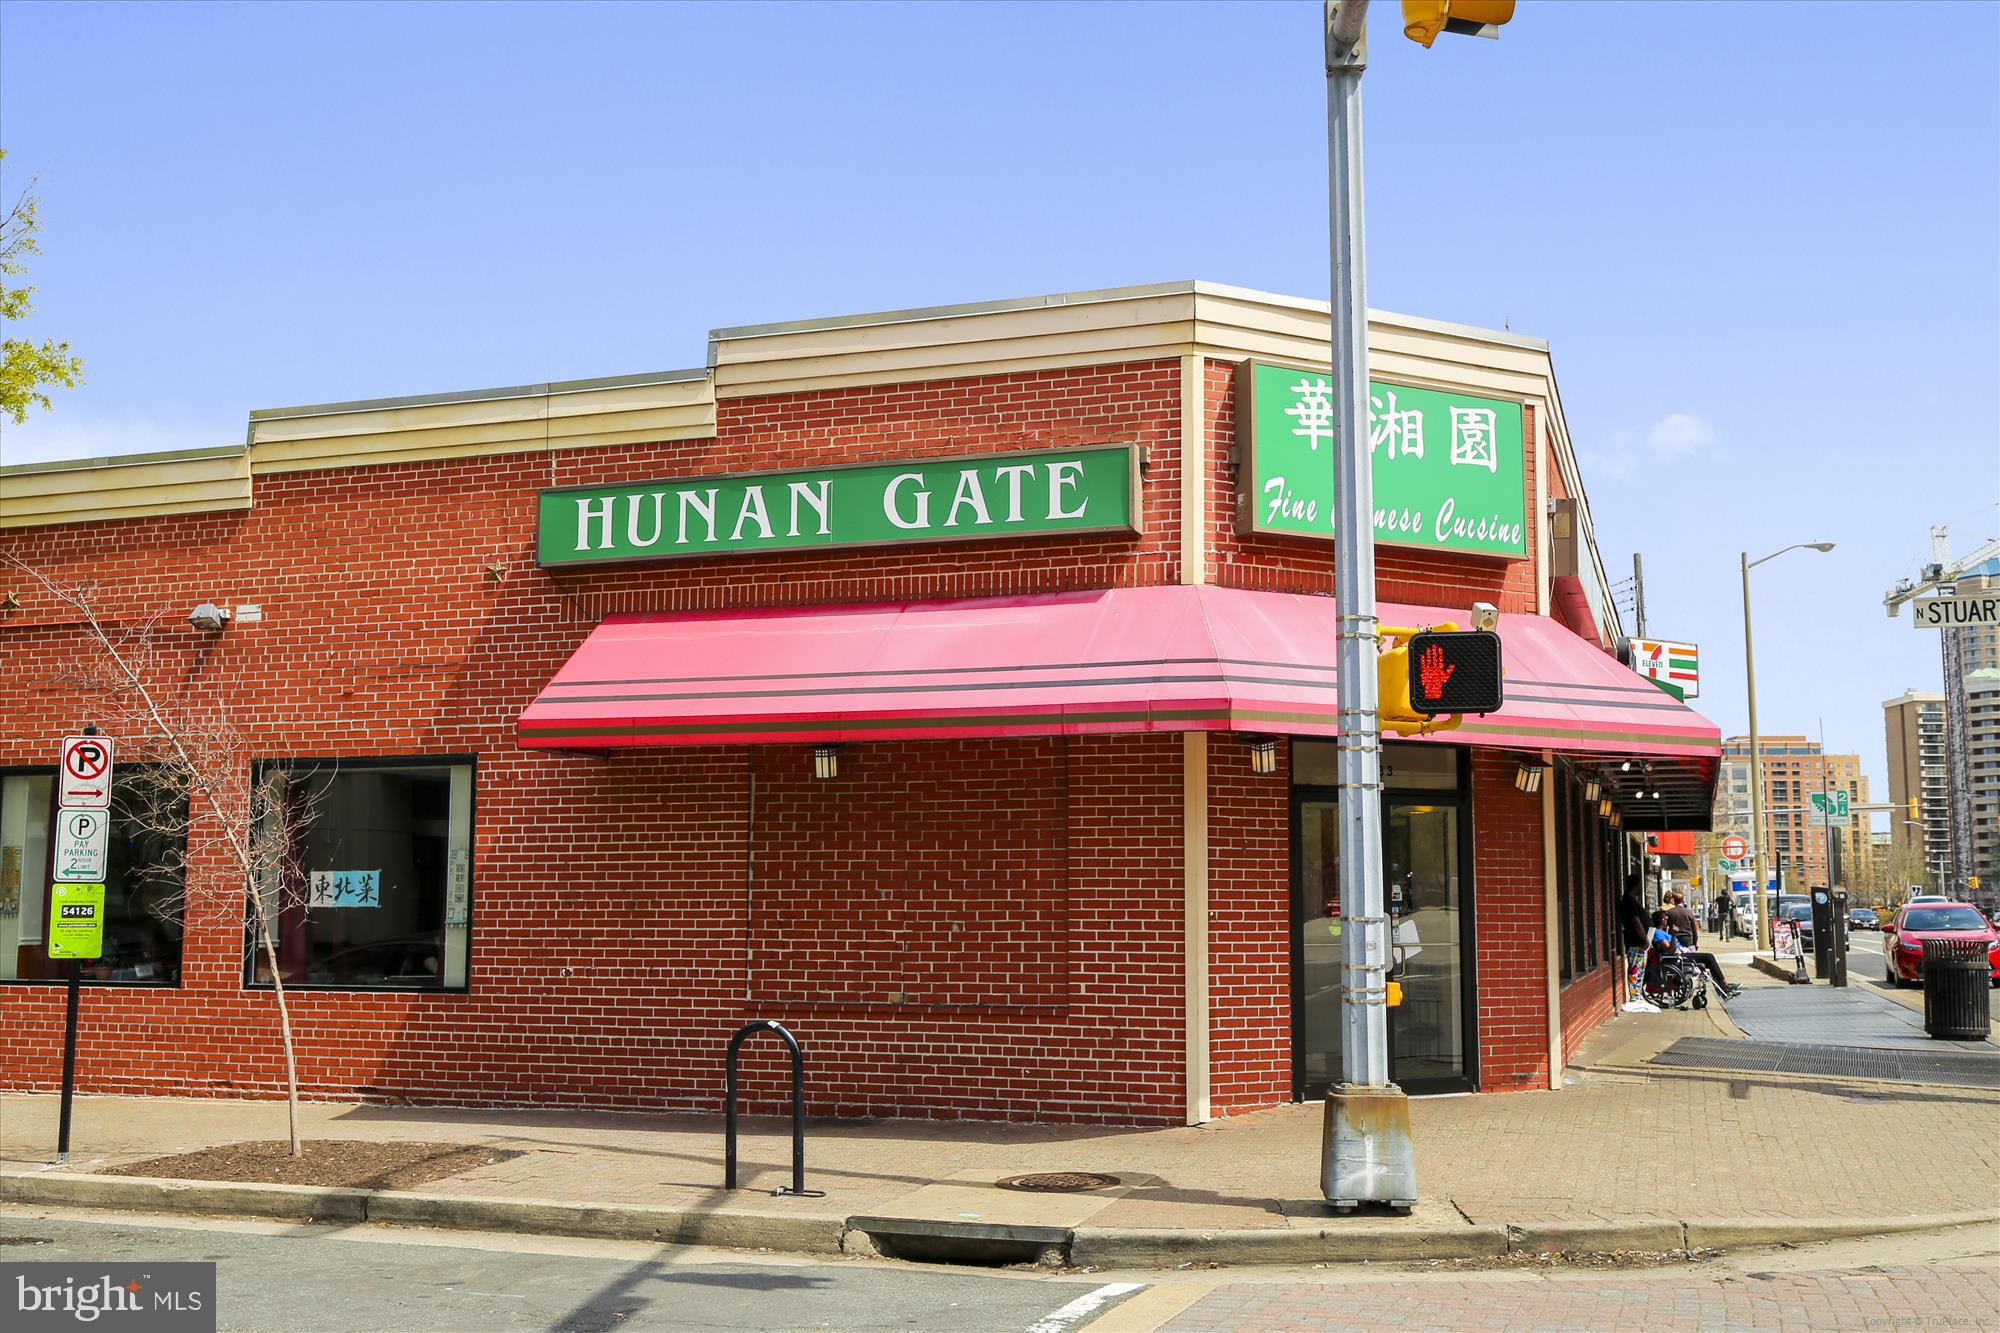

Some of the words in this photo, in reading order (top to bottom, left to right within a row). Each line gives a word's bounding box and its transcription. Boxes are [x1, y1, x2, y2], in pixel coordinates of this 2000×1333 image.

[574, 480, 832, 550] HUNAN
[883, 460, 1089, 529] GATE
[1264, 476, 1317, 524] Fine
[1331, 502, 1422, 533] nese
[1435, 497, 1521, 544] Cuisine
[1916, 608, 1924, 619] N
[74, 840, 90, 848] PAY
[64, 848, 98, 857] PARKING
[70, 858, 78, 870] 2
[314, 873, 378, 903] 東北菜
[62, 907, 94, 916] 54126
